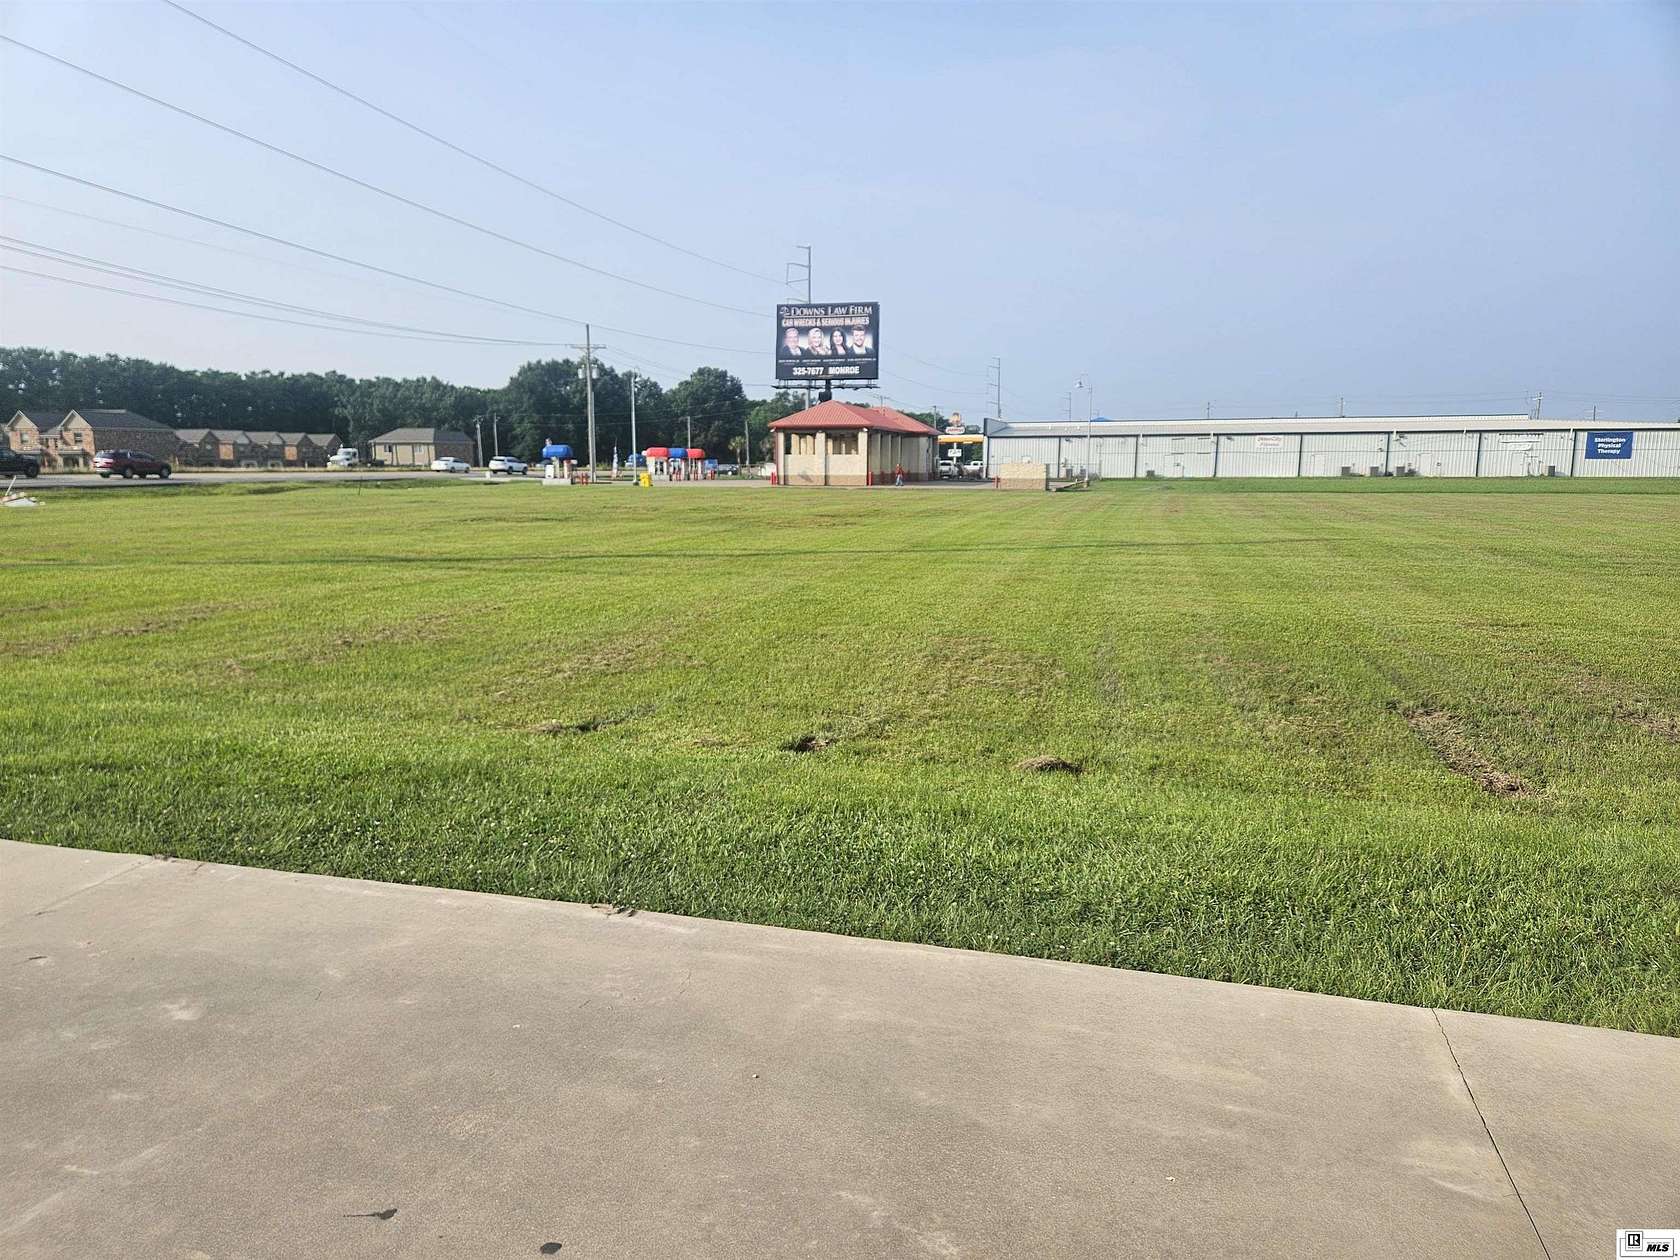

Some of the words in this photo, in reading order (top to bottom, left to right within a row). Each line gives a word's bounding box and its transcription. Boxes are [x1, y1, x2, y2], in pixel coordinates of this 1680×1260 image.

[849, 305, 873, 315] FIRM
[793, 366, 824, 376] 325-7677
[828, 365, 860, 375] MONROE
